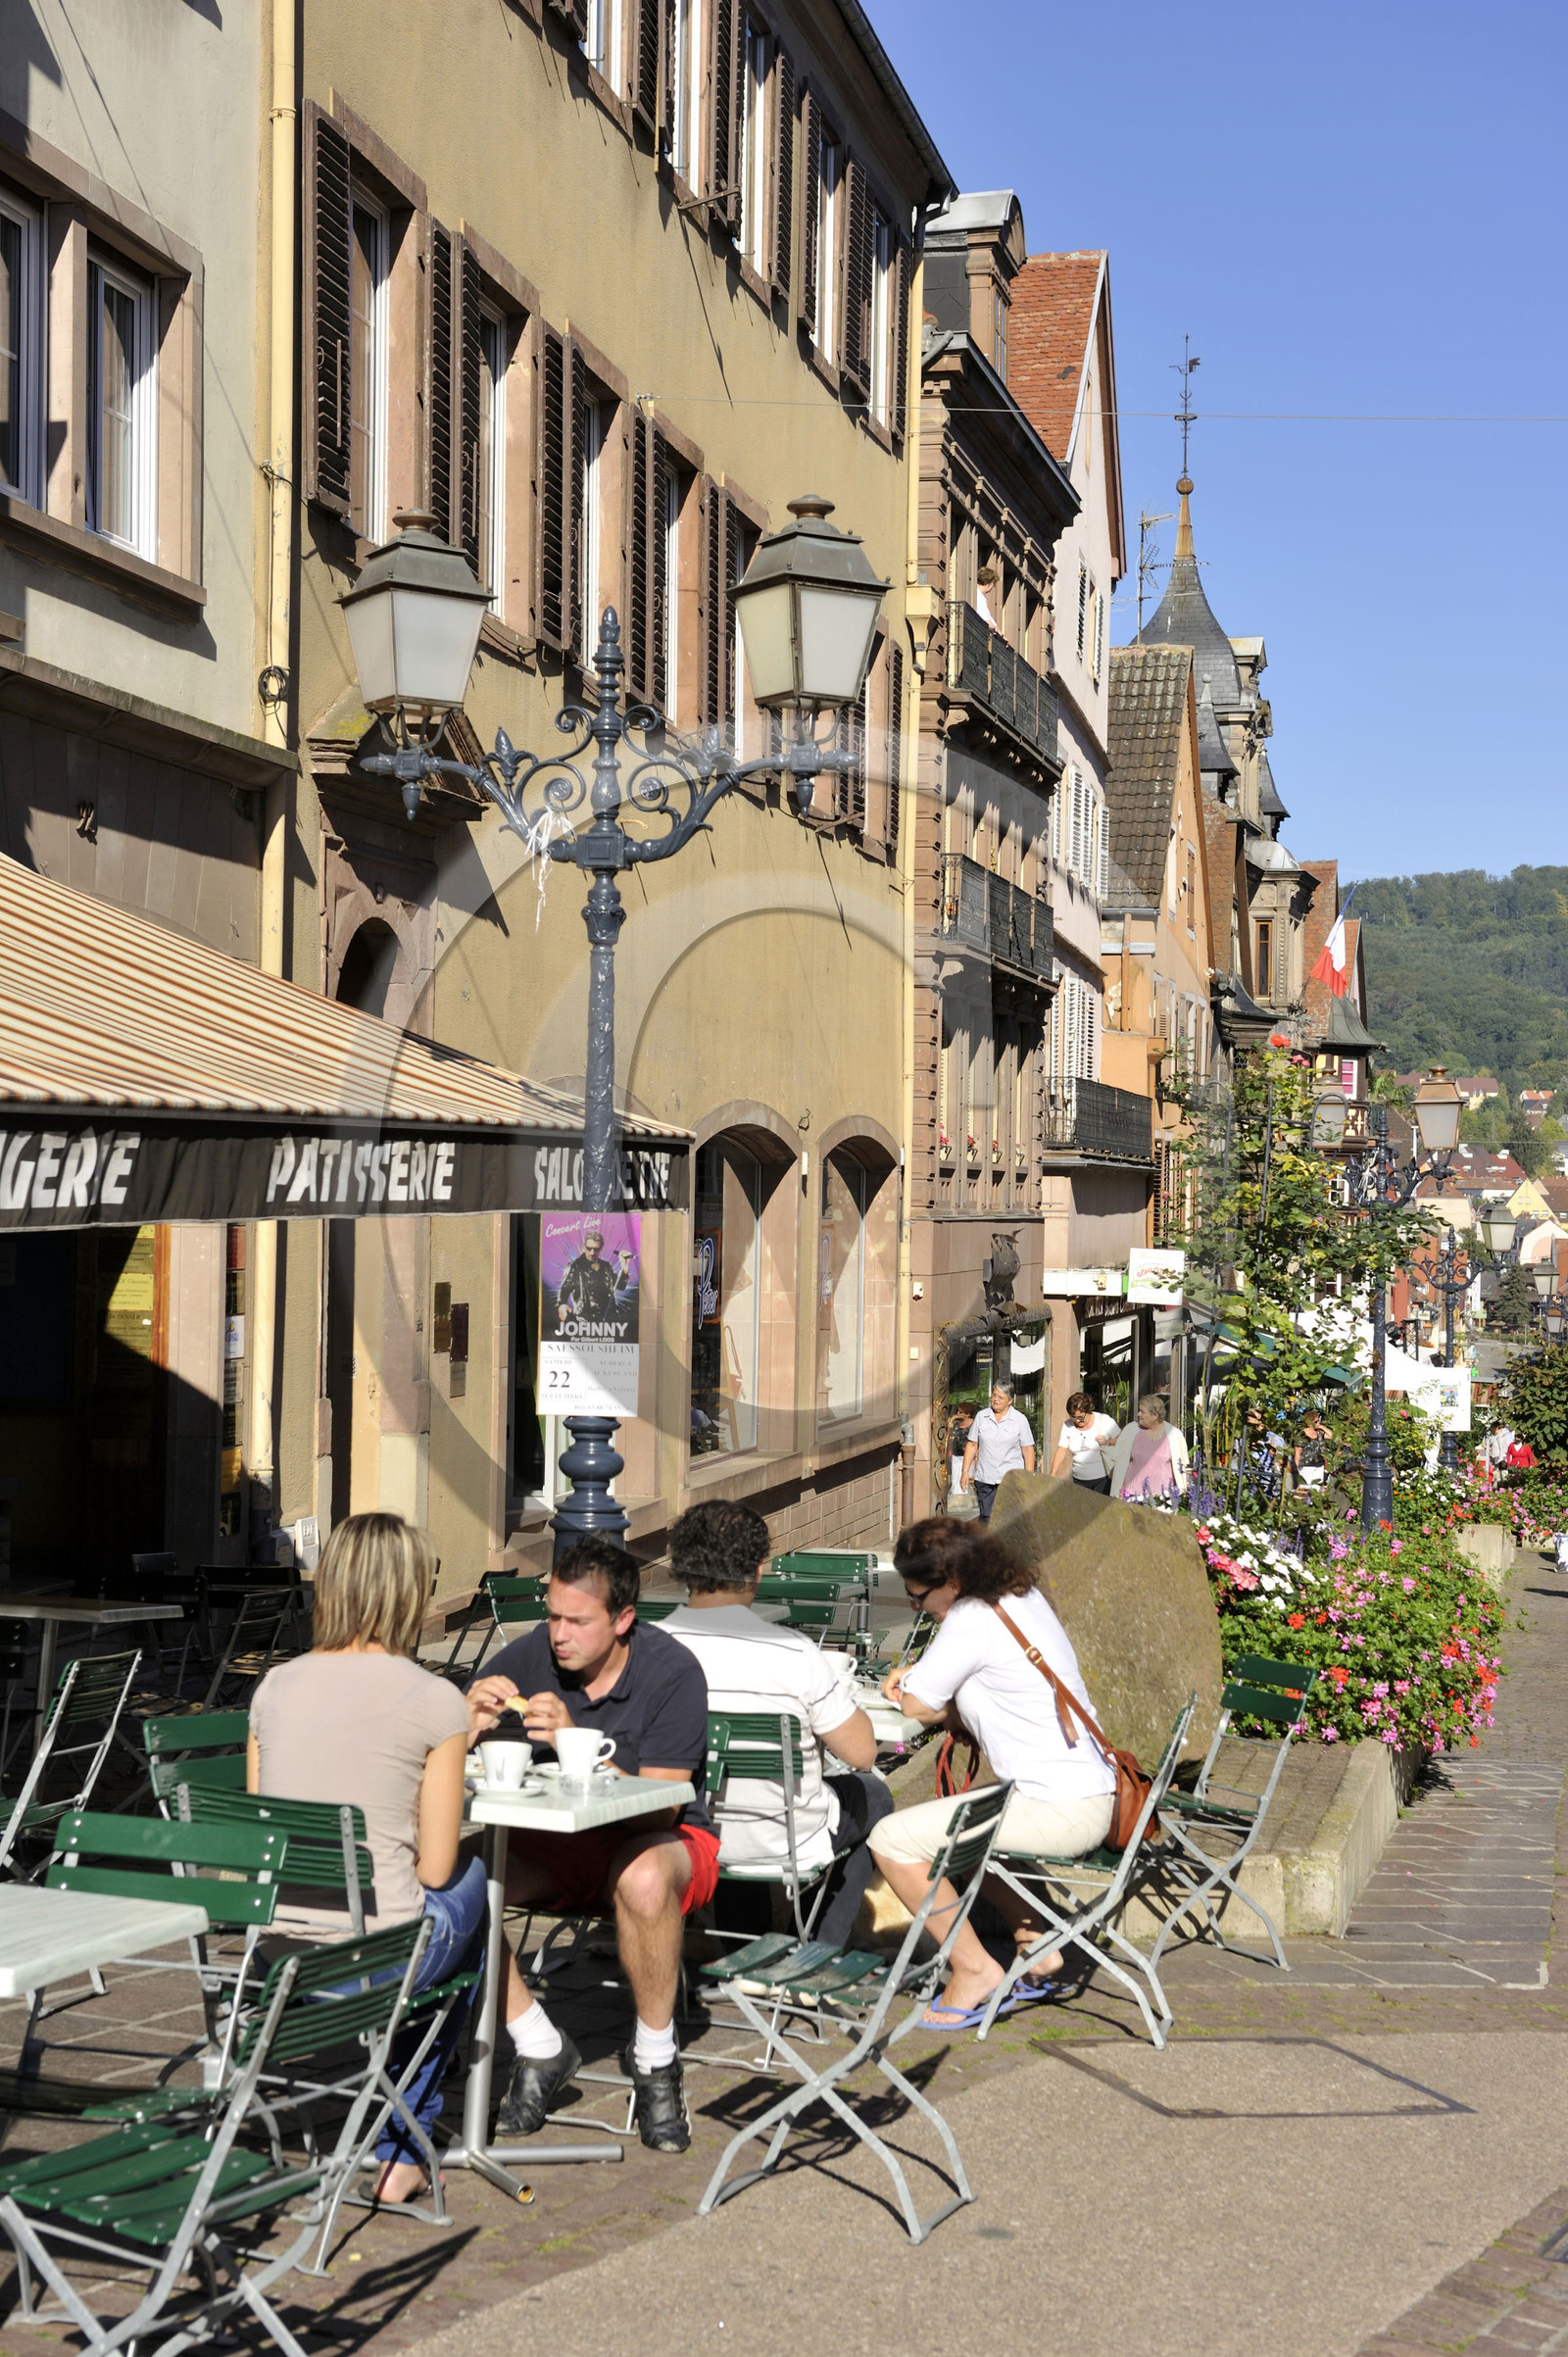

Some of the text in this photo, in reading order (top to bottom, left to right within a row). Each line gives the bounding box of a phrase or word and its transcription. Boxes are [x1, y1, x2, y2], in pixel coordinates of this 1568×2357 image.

[266, 1131, 456, 1203] PATISSERIE
[533, 1147, 585, 1201] SALO
[545, 1216, 601, 1238] Concert Live
[554, 1320, 629, 1337] JOHNNY
[548, 1370, 570, 1388] 22
